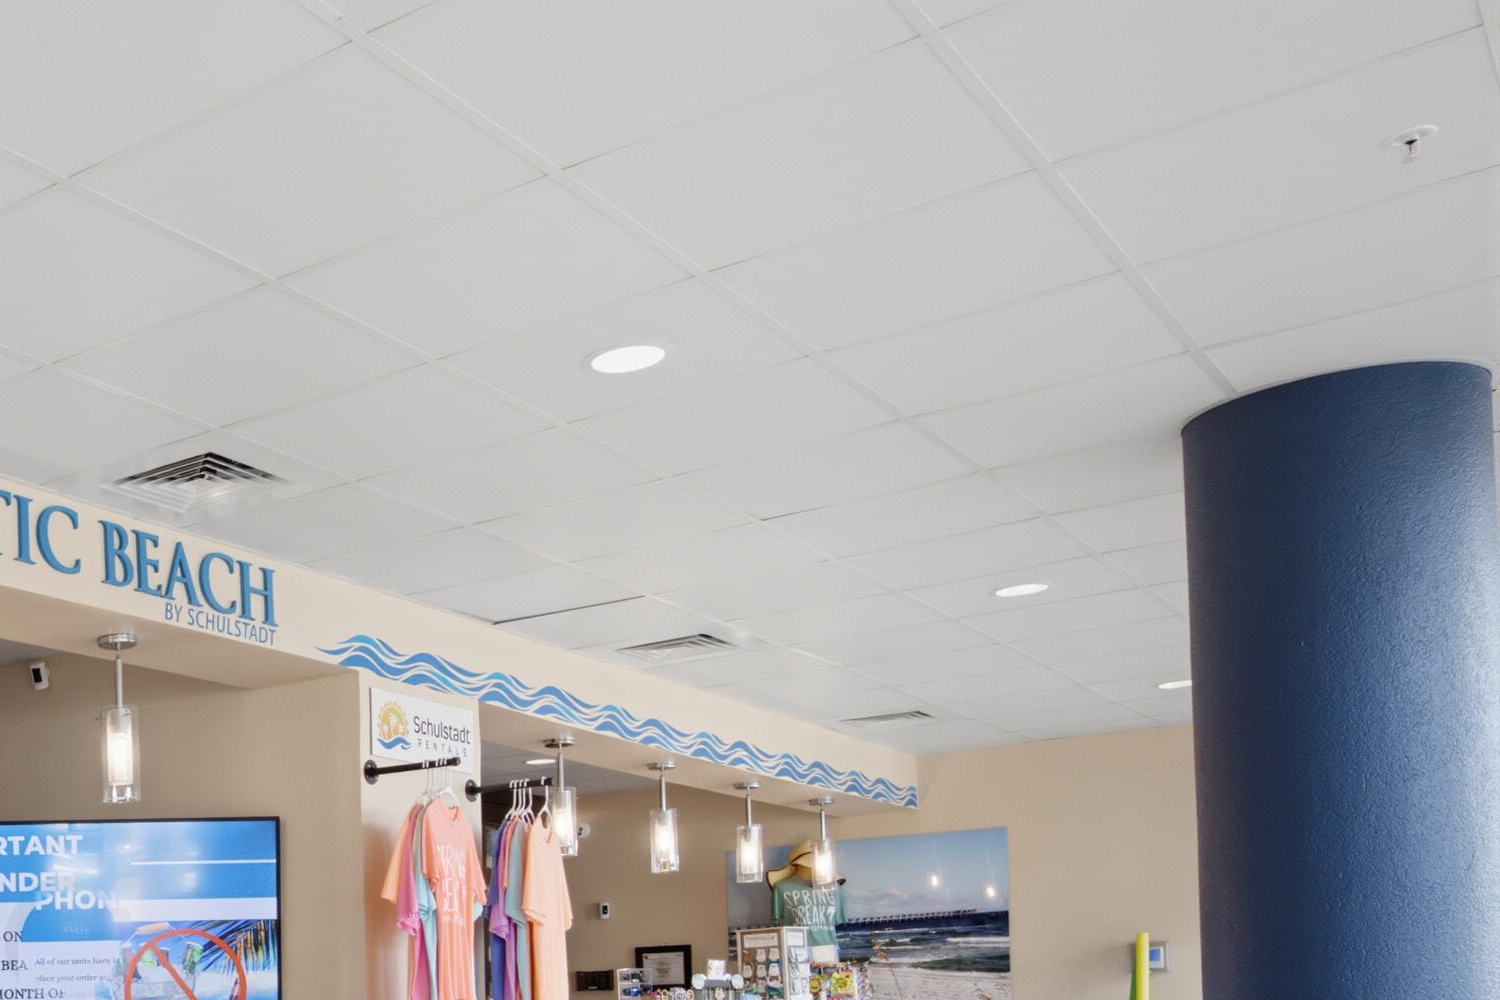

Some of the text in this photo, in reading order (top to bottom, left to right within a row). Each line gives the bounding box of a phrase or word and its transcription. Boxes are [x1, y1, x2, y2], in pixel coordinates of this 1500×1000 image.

[98, 520, 279, 627] BEACH
[164, 602, 277, 646] BY SCHULSTADT
[413, 715, 471, 745] Schulstadt
[417, 738, 468, 757] RENTALS
[3, 930, 22, 942] ON
